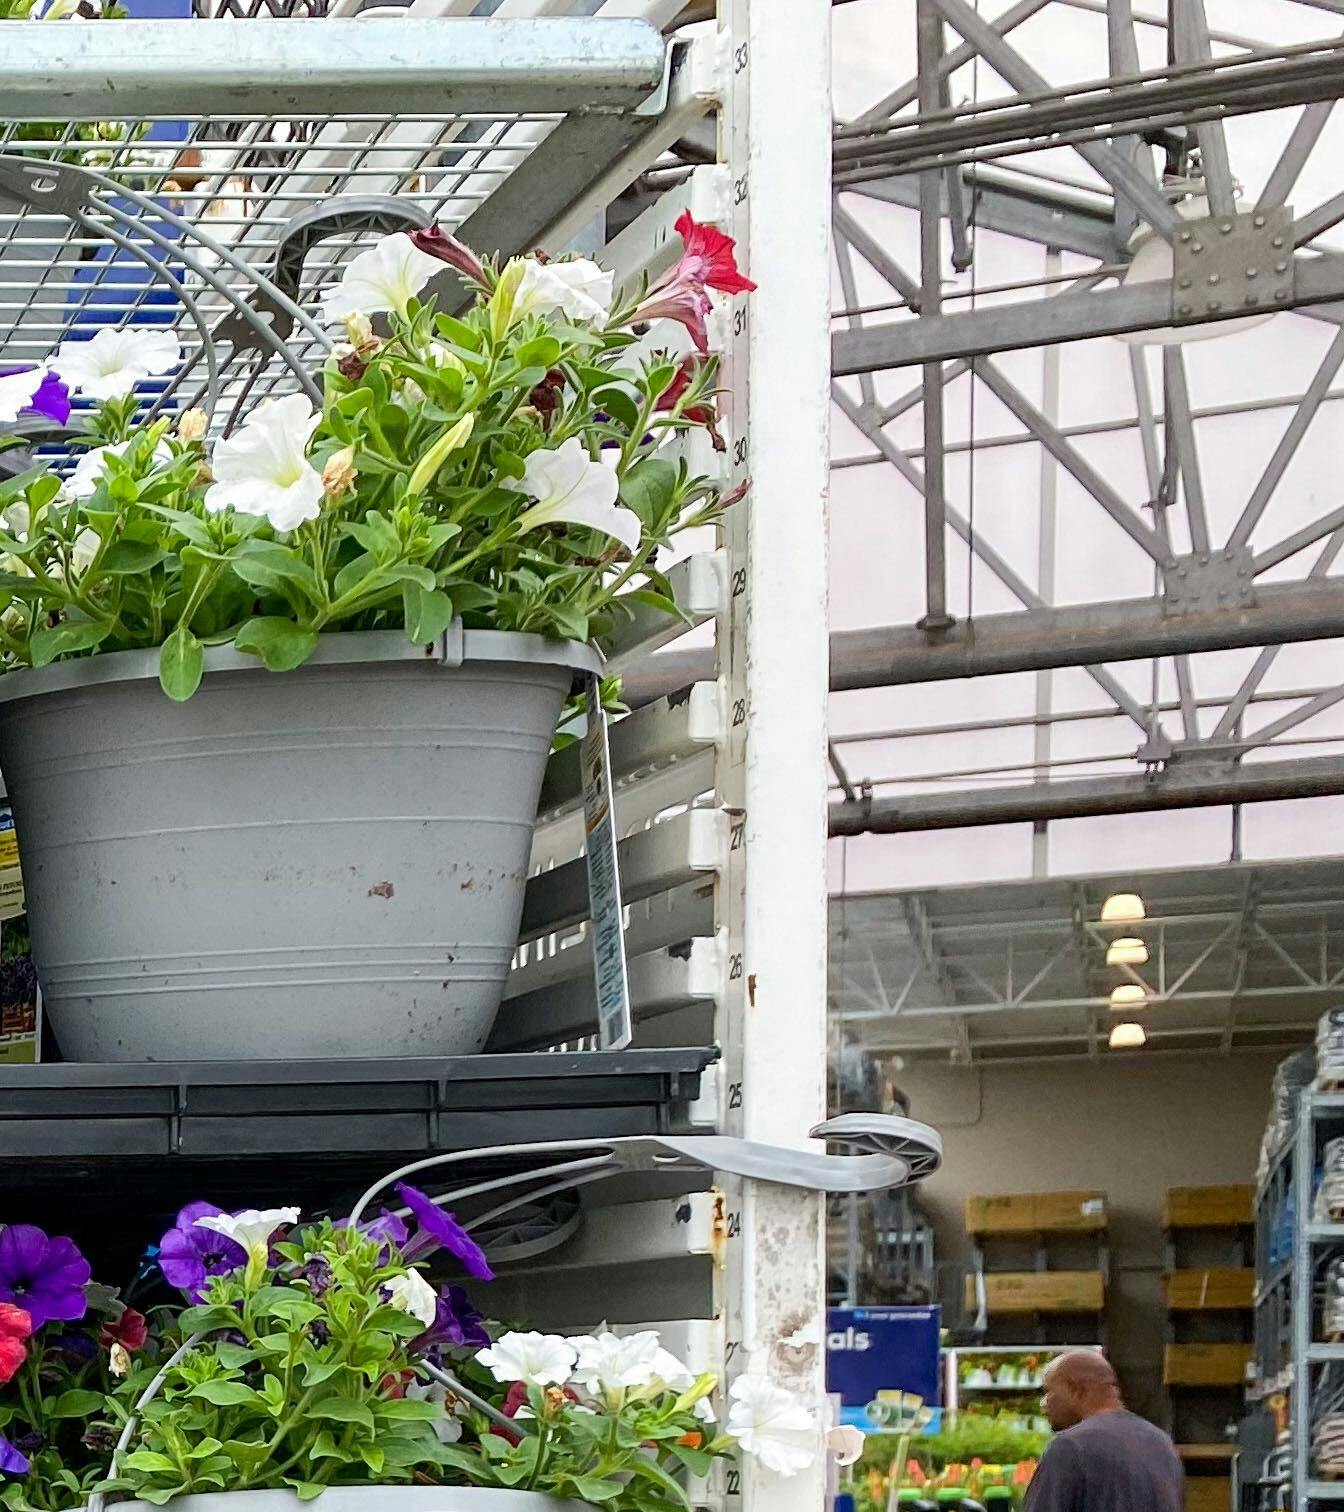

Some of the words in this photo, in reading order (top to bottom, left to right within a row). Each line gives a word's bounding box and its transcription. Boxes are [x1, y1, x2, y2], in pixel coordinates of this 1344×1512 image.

[734, 42, 748, 75] 33
[734, 305, 747, 336] 31
[734, 437, 747, 466] 30
[732, 568, 746, 597] 29
[732, 699, 745, 727] 28
[730, 823, 743, 851] 27
[729, 1082, 742, 1109] 25
[727, 1212, 740, 1239] 24
[828, 1326, 870, 1350] als
[726, 1470, 740, 1495] 22
